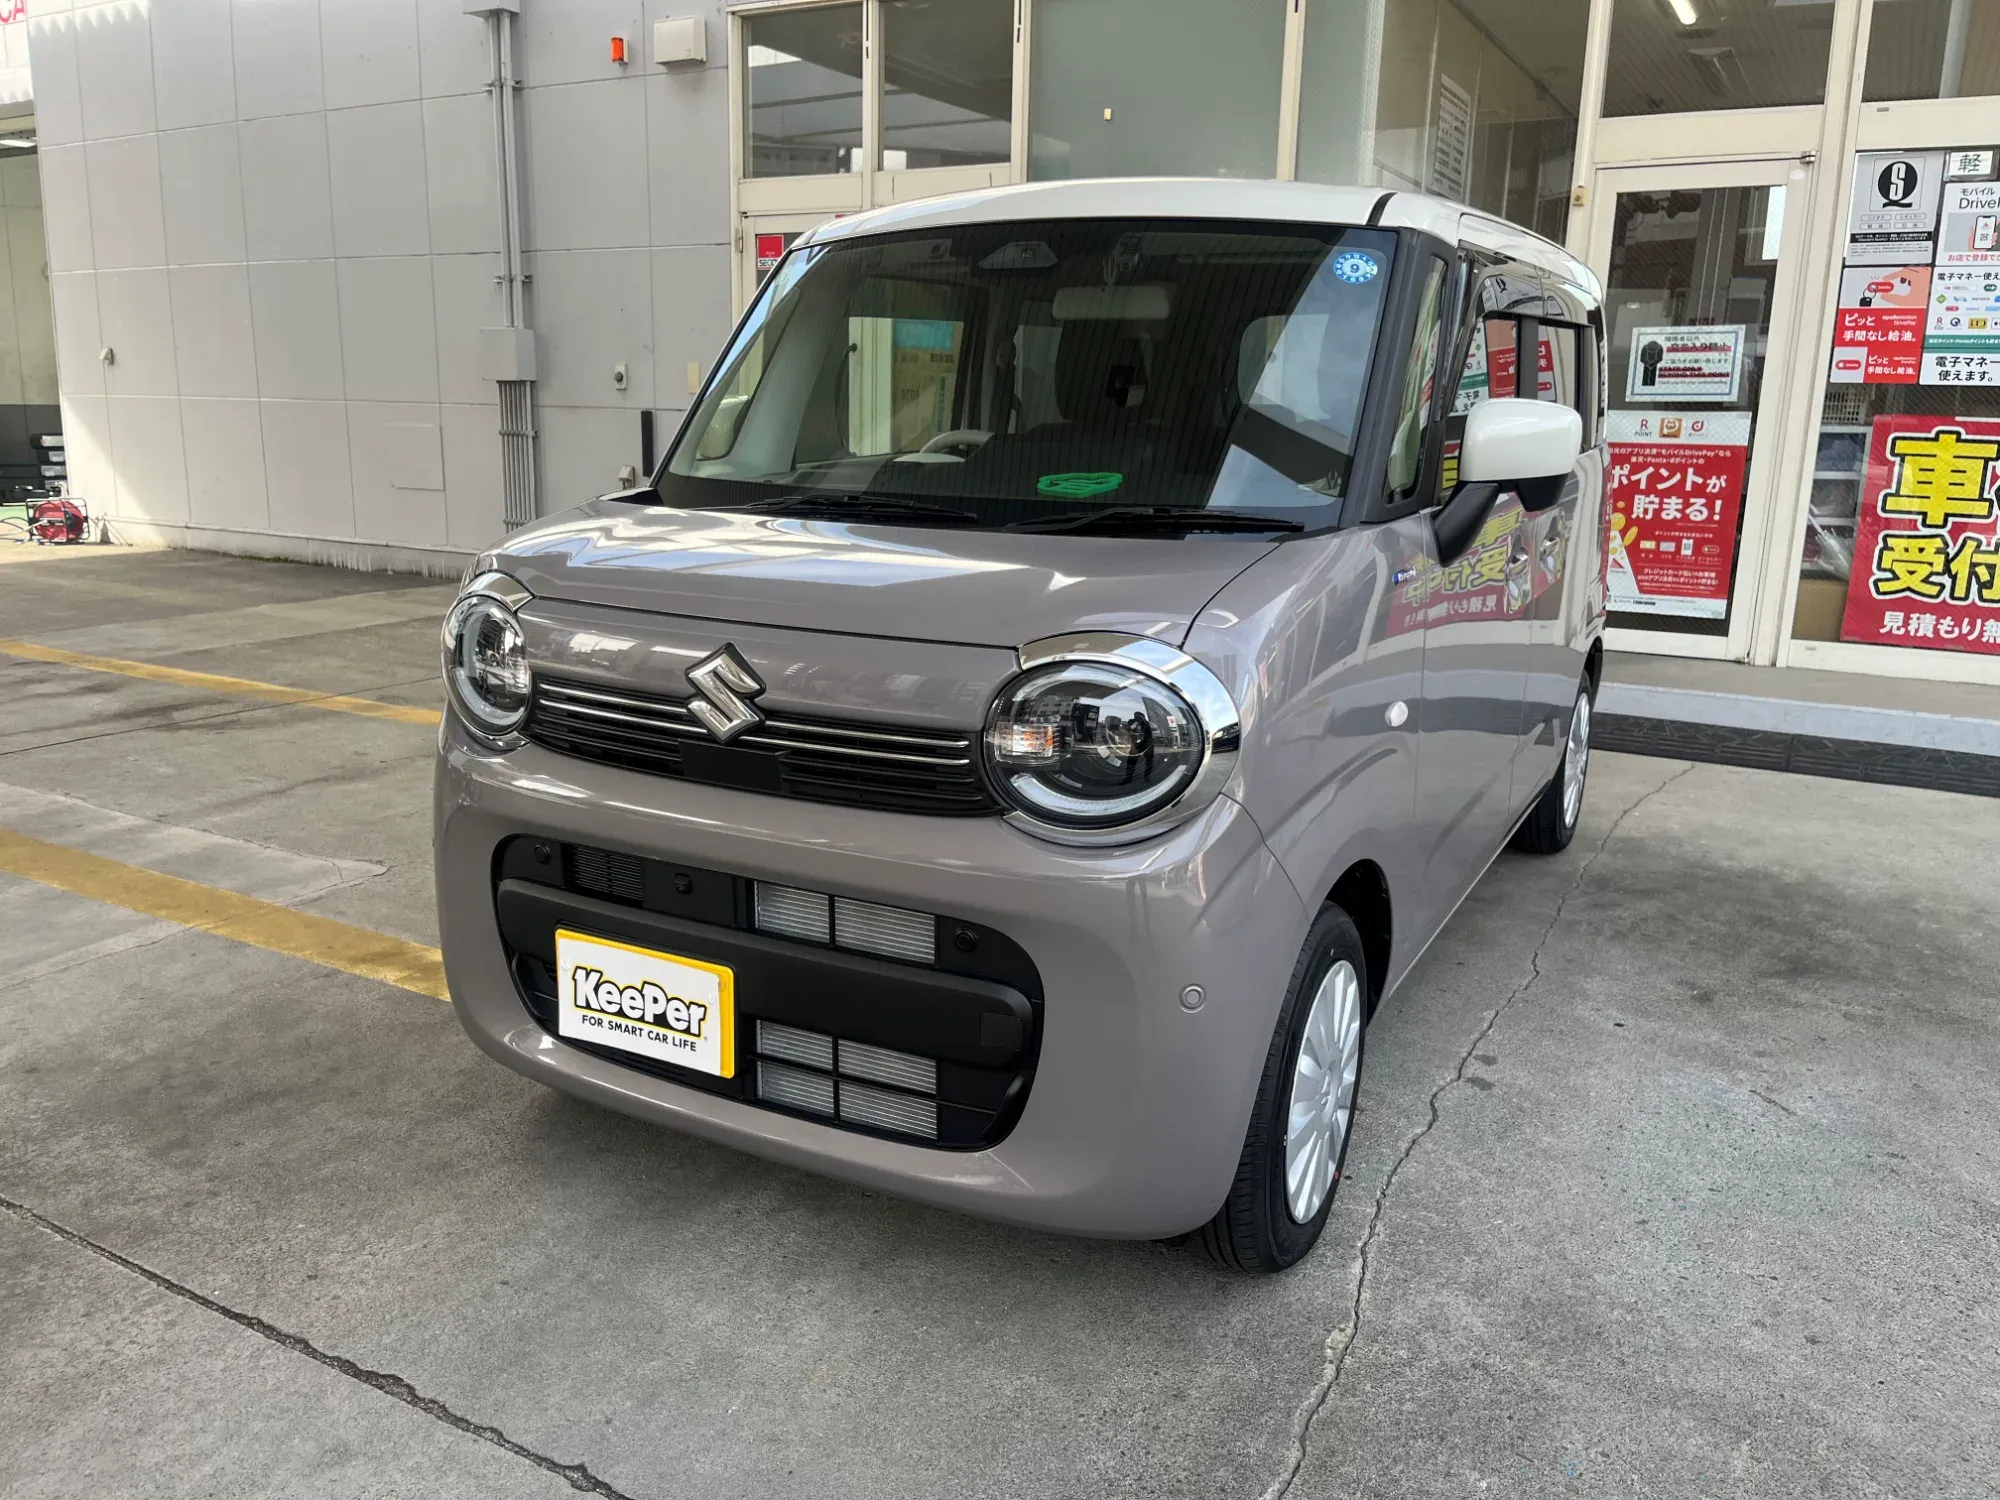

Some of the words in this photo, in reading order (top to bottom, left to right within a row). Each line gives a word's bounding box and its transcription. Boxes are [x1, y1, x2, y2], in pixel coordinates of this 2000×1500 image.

[1958, 153, 1982, 173] 軽
[1961, 187, 1995, 197] モバイル
[759, 258, 778, 267] SECO
[1845, 312, 1875, 326] ピッと
[1842, 330, 1916, 342] 手間なし給油。
[1868, 354, 1889, 364] ピッと
[1935, 356, 2000, 368] 電子マネー
[1867, 366, 1916, 375] 手間なし給油。
[1938, 370, 1993, 382] 使えます。
[1611, 463, 1727, 494] ポイントが
[1882, 430, 2000, 528] 車
[1631, 494, 1723, 521] 貯まる!
[572, 966, 707, 1038] KeePer
[582, 1014, 604, 1028] FOR
[608, 1020, 645, 1039] SMART
[647, 1030, 669, 1044] CAR
[672, 1039, 697, 1052] LIFE
